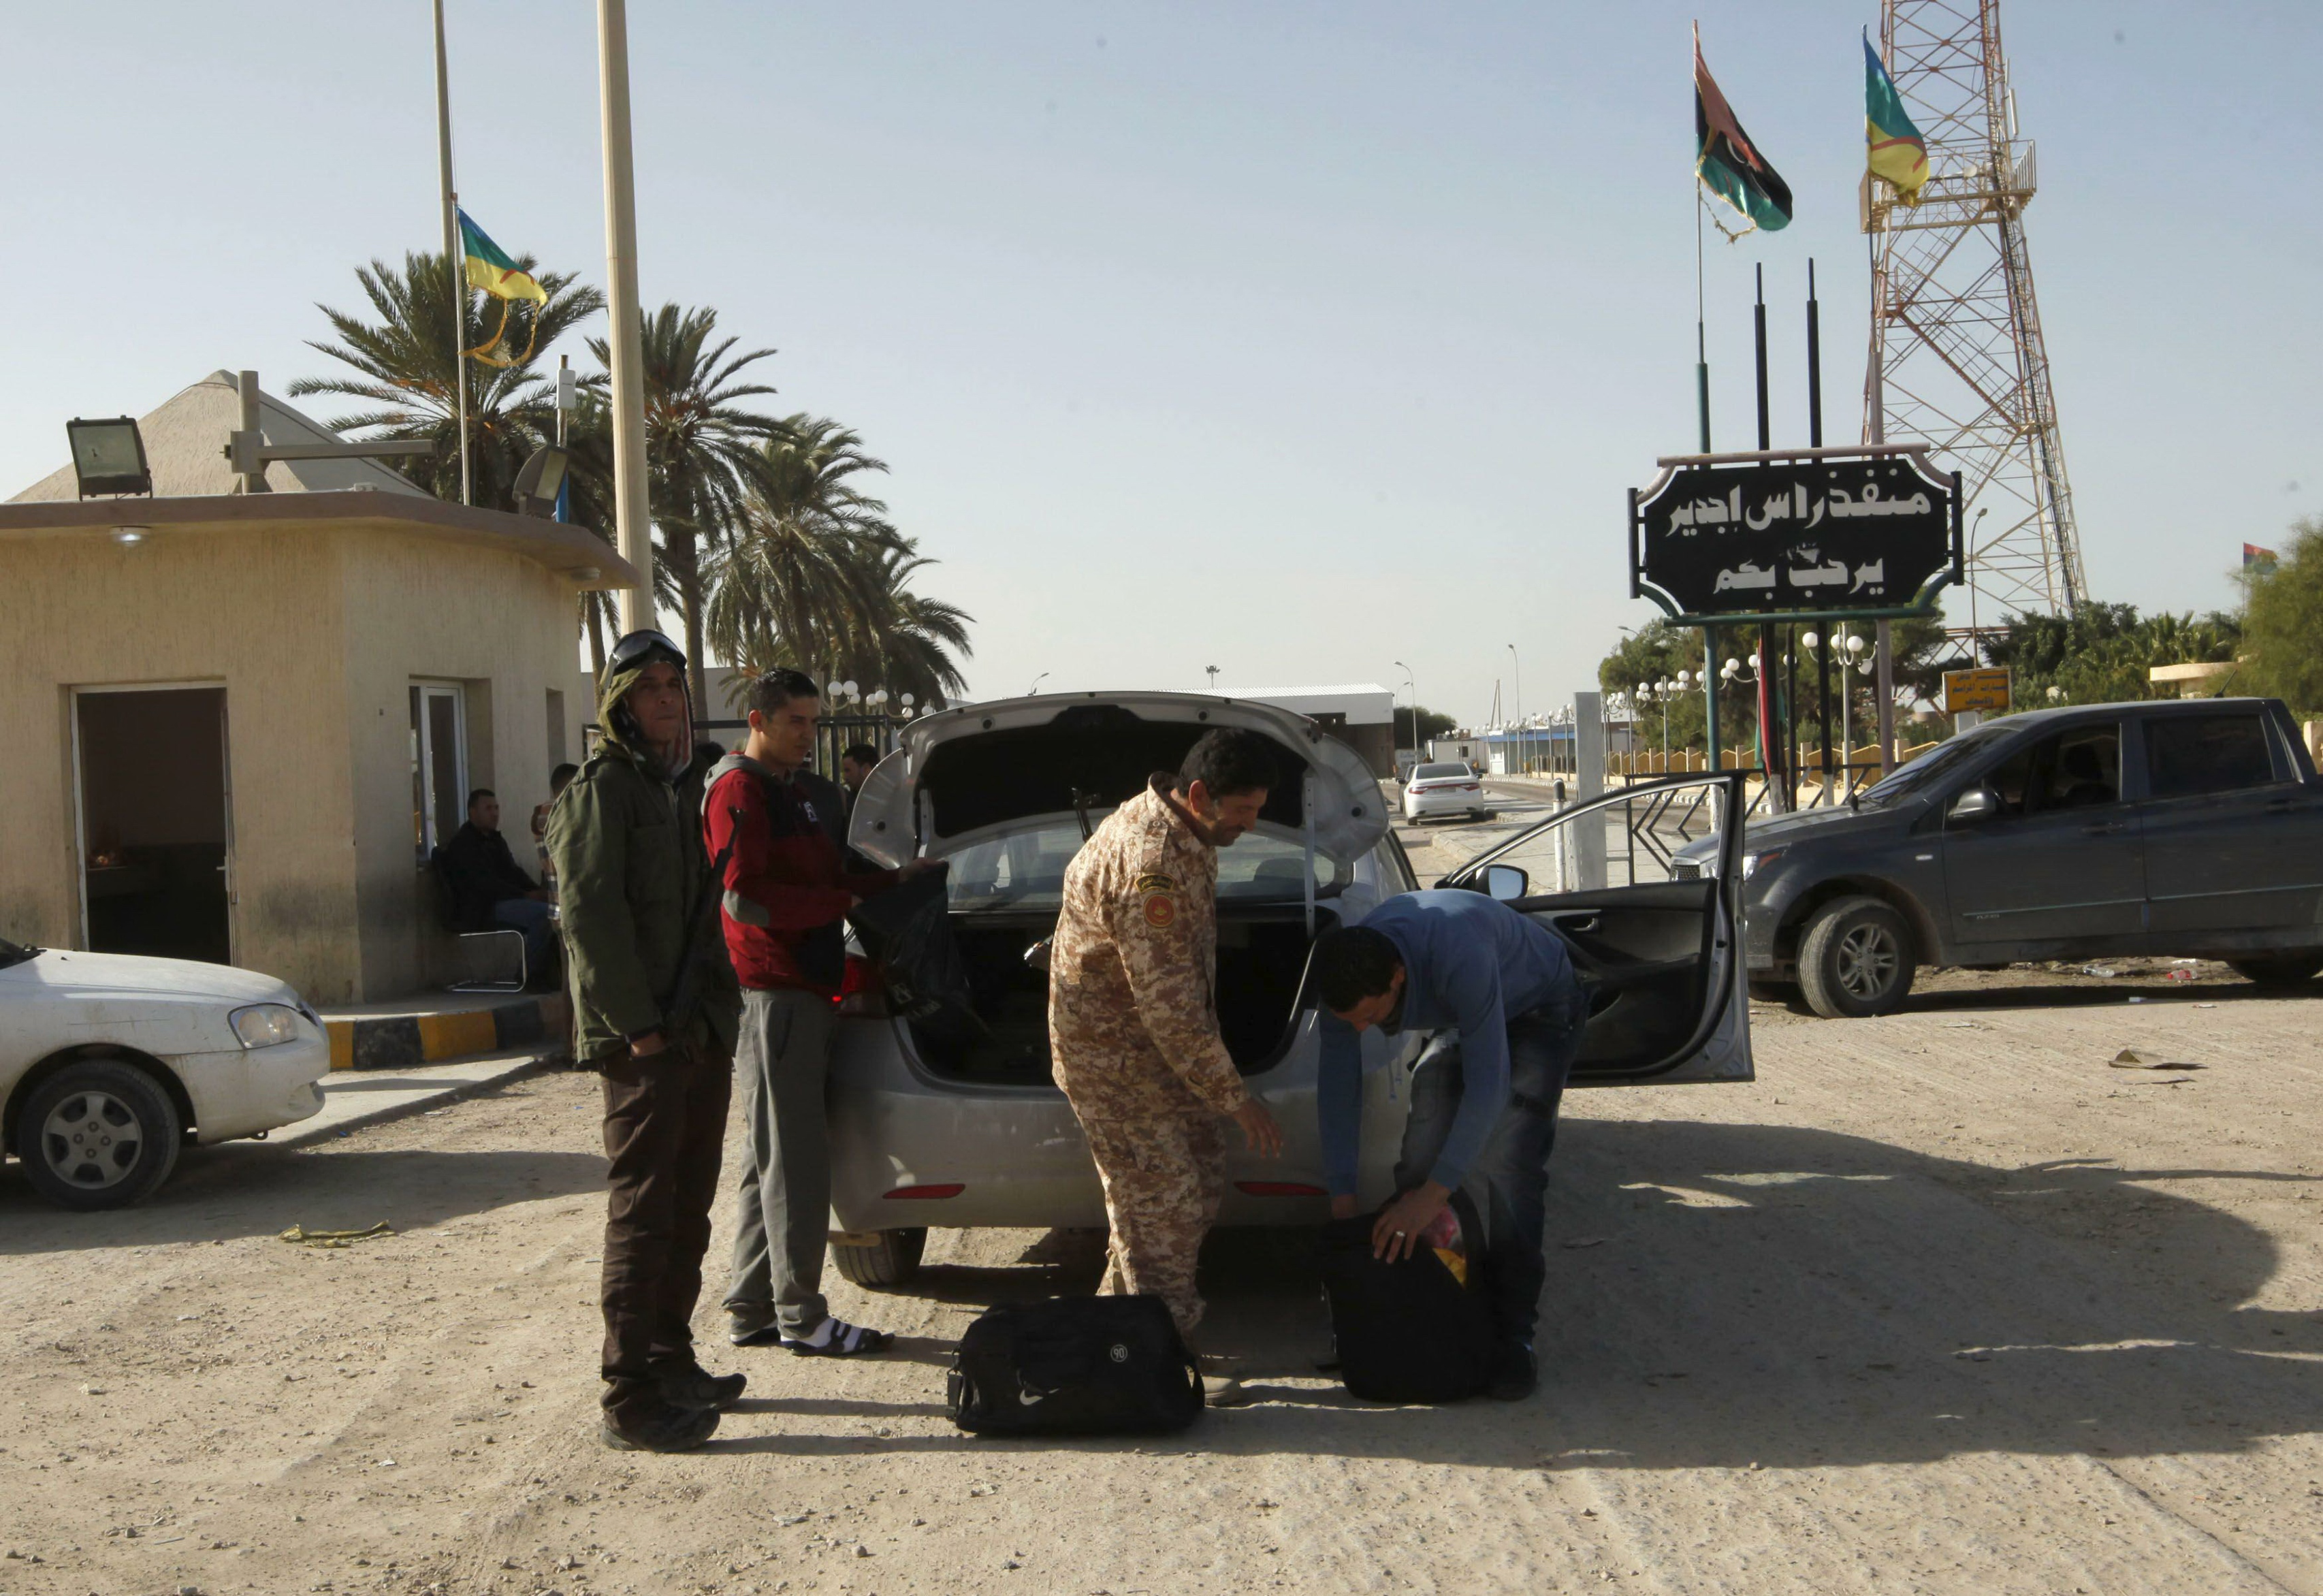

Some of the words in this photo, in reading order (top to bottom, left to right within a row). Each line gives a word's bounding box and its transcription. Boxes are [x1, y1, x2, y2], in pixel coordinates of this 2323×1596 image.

[1746, 481, 1825, 531] راس
[1829, 468, 1931, 517] منفذ
[1712, 559, 1776, 601] بكم
[1789, 558, 1885, 598] يرحب
[1112, 1347, 1125, 1360] 90
